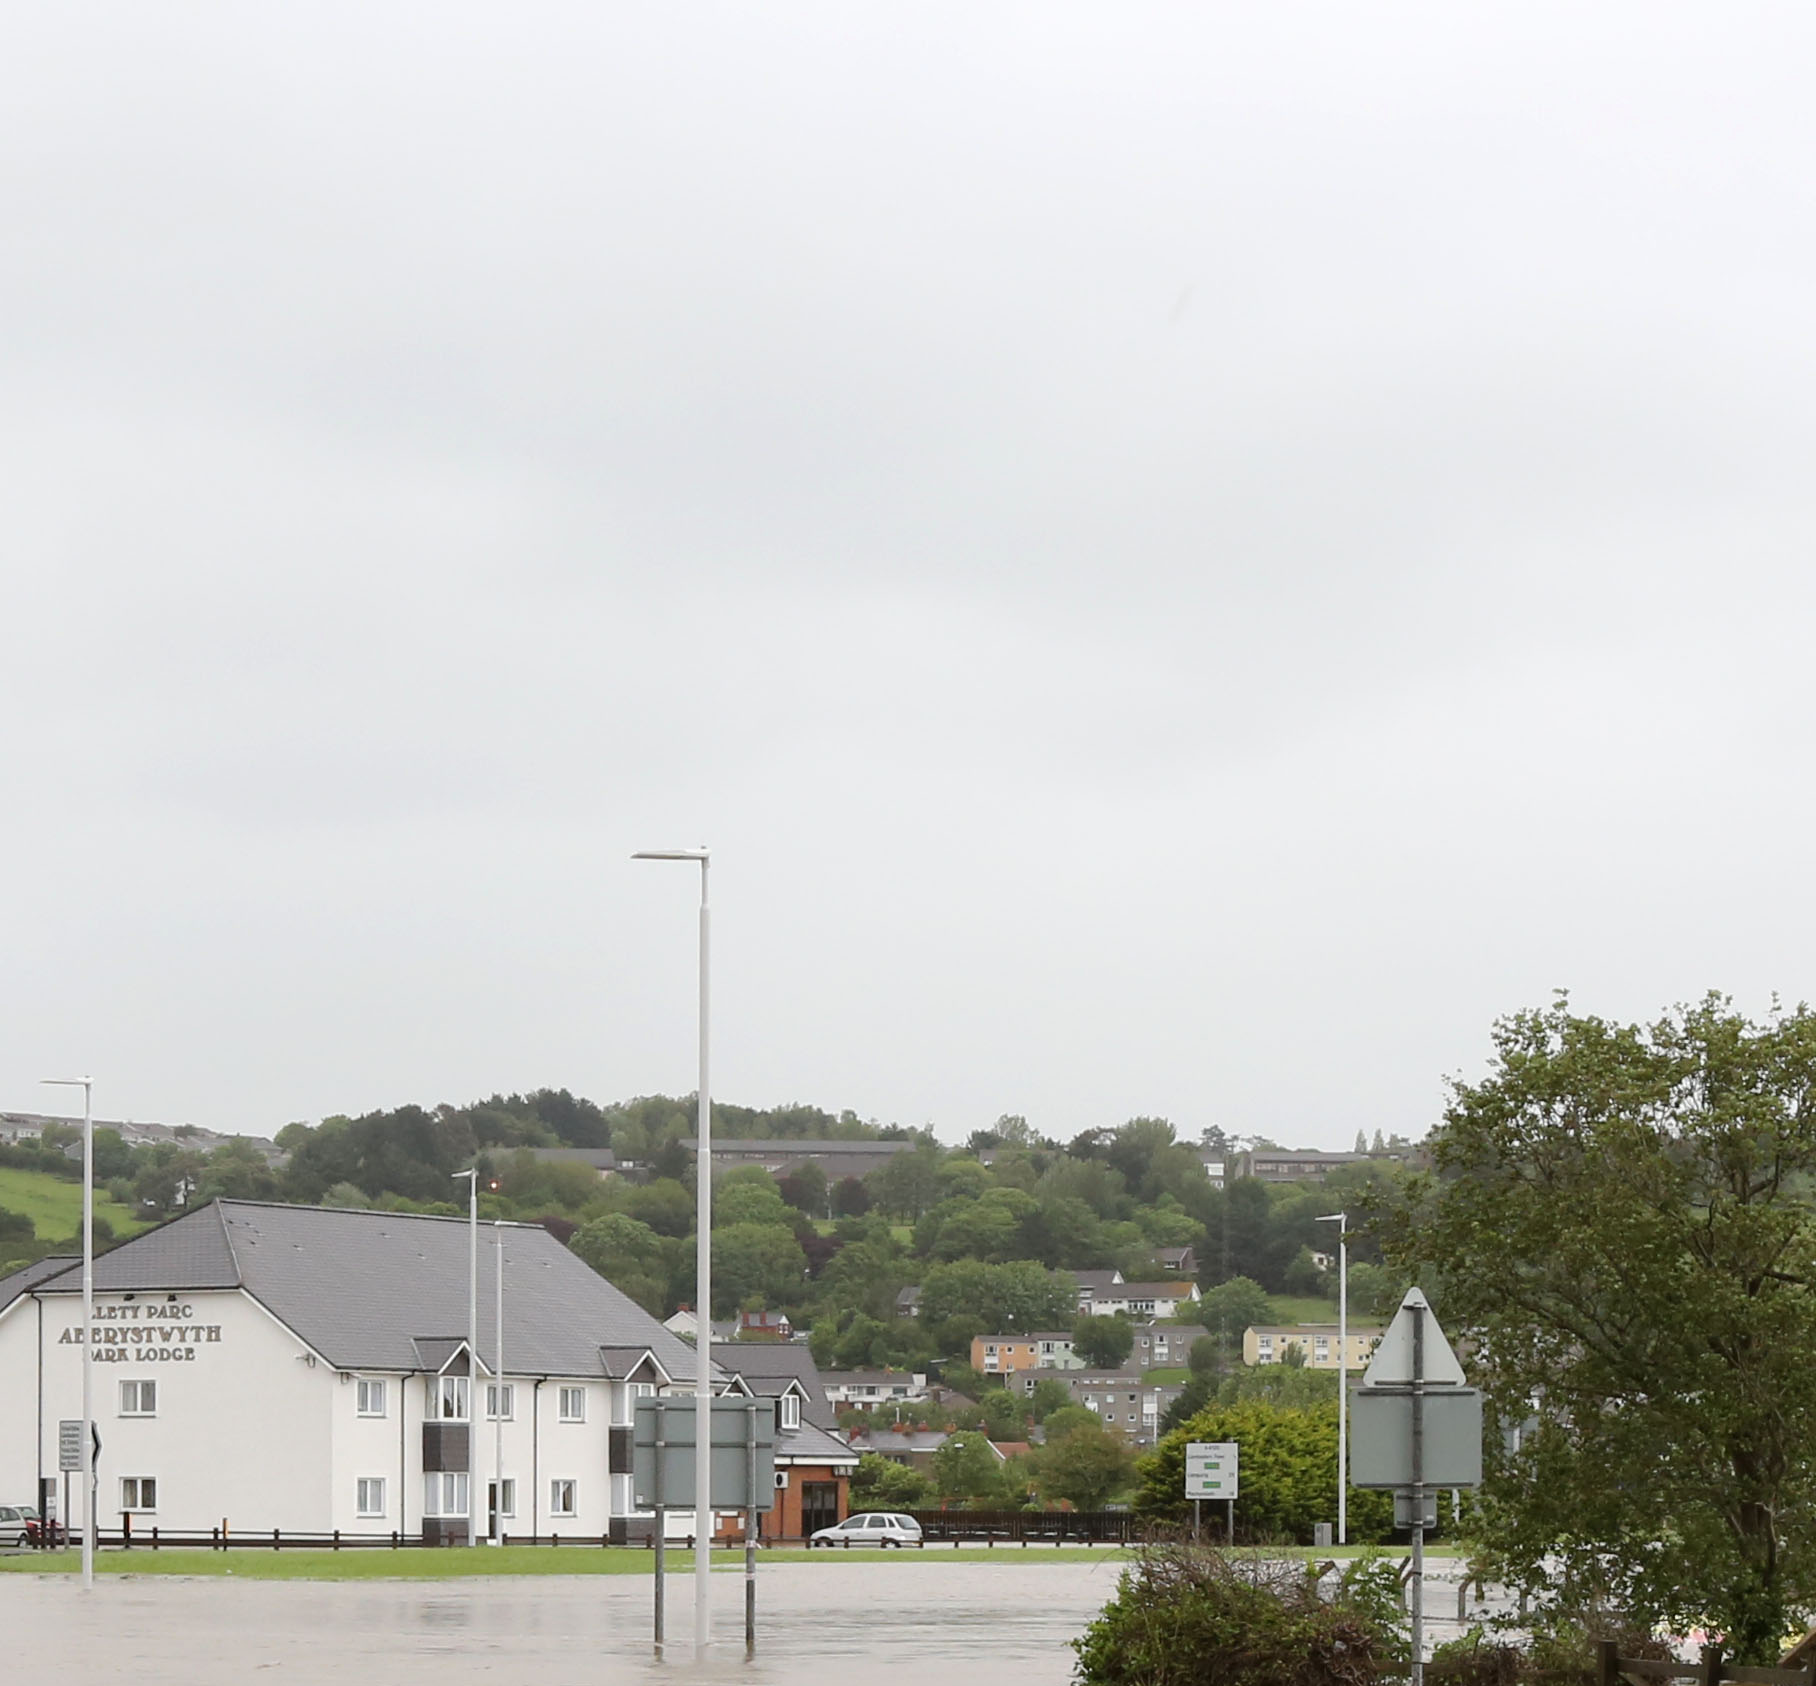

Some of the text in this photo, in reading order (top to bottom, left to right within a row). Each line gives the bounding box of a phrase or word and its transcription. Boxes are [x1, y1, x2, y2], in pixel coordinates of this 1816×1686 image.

[91, 1304, 193, 1320] LETY PARC
[91, 1347, 196, 1363] ARK LODGE
